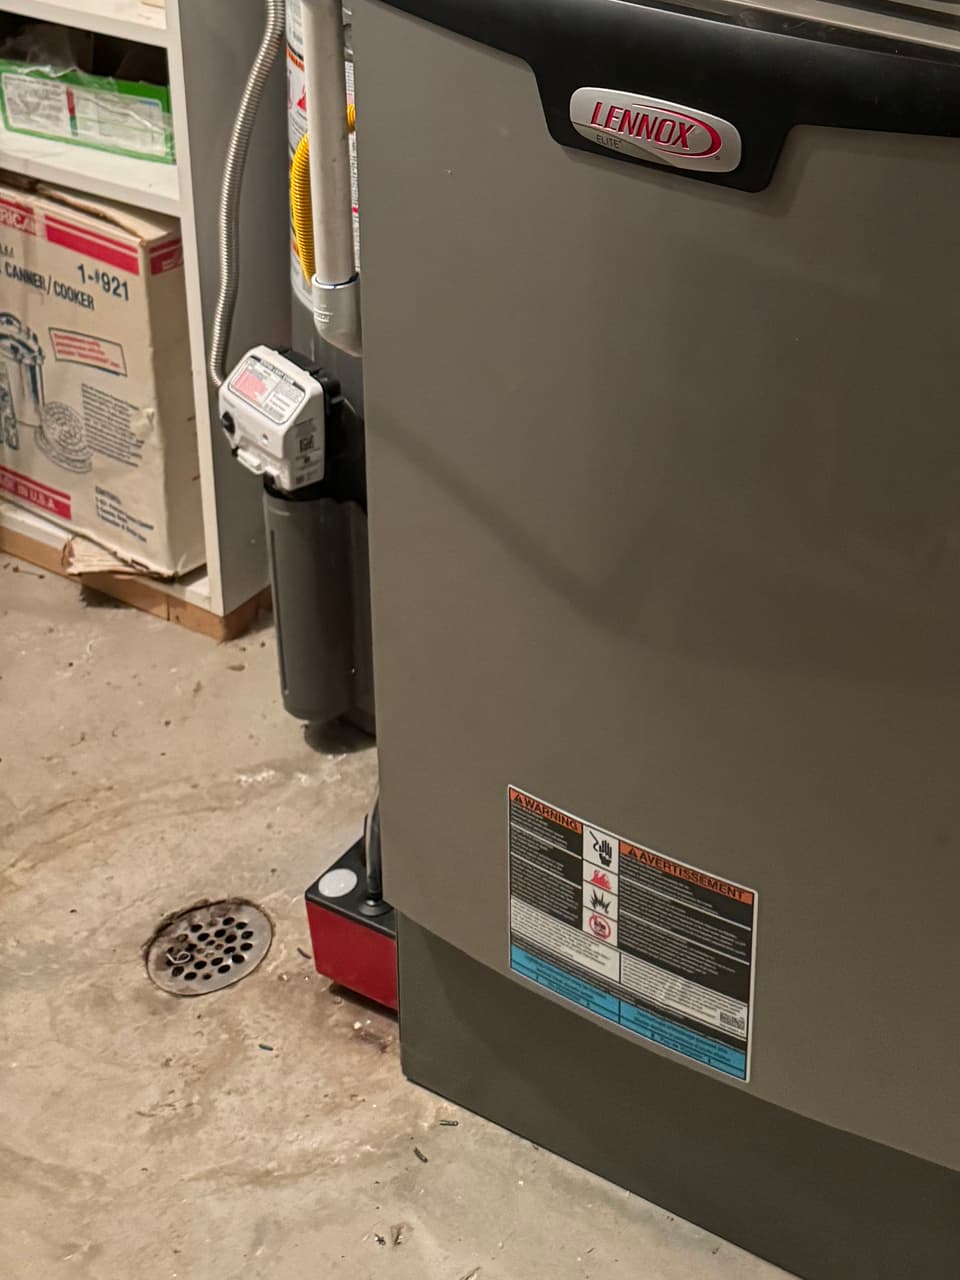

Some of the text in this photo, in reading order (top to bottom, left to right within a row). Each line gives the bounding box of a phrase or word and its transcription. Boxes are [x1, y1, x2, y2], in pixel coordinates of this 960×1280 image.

[590, 101, 696, 151] LENNOX
[596, 134, 619, 149] ELITE
[525, 797, 581, 831] WARNING
[638, 851, 747, 902] AVERTISSEMENT
